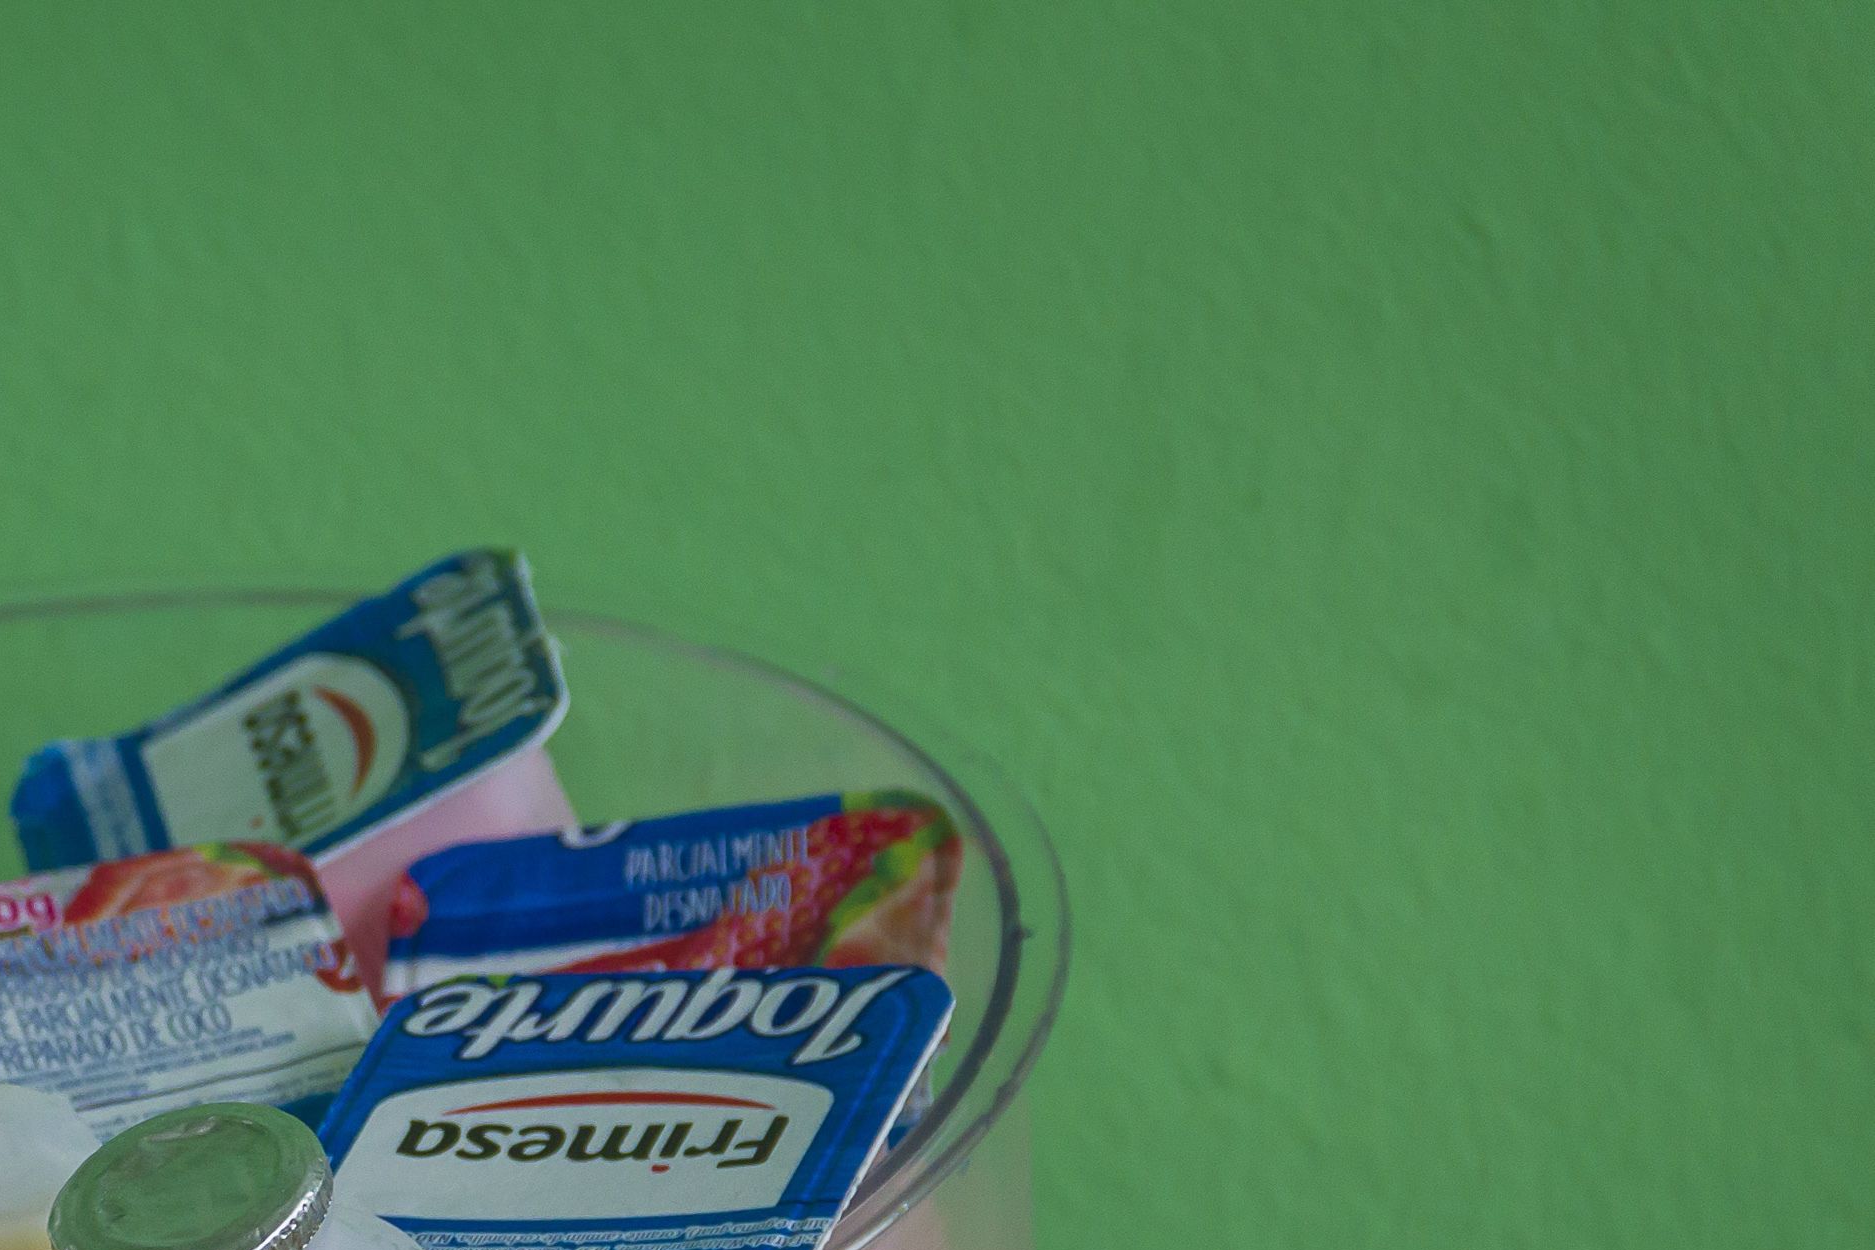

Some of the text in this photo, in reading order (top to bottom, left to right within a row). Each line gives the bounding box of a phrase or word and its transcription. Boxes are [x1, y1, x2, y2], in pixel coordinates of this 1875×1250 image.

[625, 828, 809, 888] PARCIALMENTE
[642, 873, 792, 932] DESNATADO
[12, 969, 195, 1039] PARCIALMENTE
[129, 1011, 164, 1051] DE
[163, 996, 233, 1043] COCO
[393, 1114, 791, 1173] Frimesa
